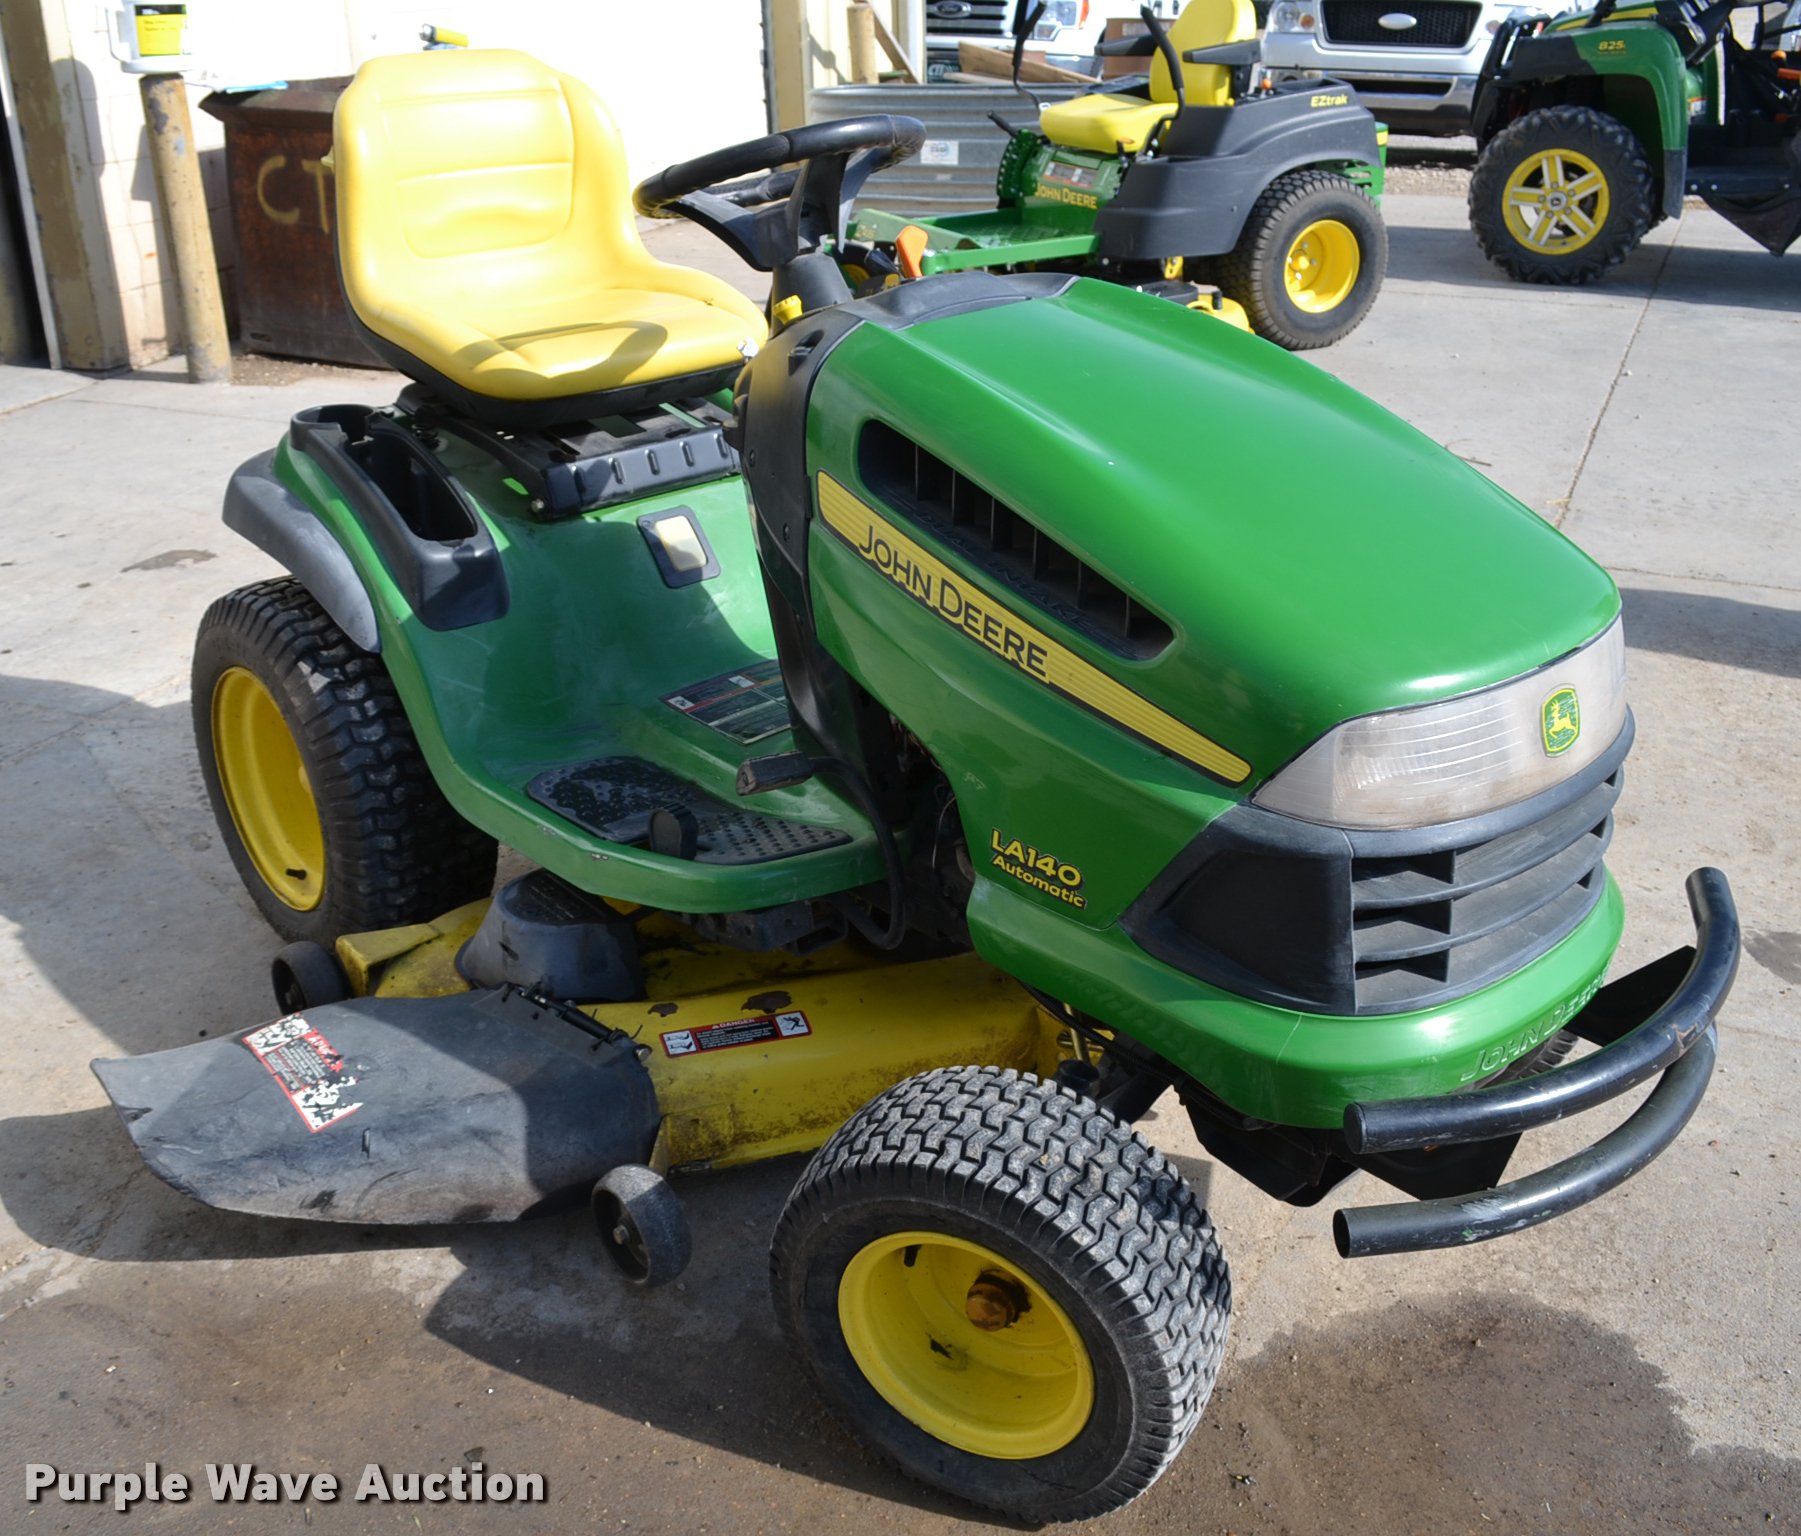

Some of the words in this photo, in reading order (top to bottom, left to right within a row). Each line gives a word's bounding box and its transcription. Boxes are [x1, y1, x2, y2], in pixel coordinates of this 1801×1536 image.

[1310, 93, 1349, 107] EZtrak
[1034, 183, 1061, 200] JOHN
[1062, 188, 1098, 209] DEERE
[859, 525, 931, 601] JOHN
[940, 577, 1048, 670] DEERE
[991, 828, 1083, 888] LA140
[992, 855, 1086, 909] Automatic
[719, 1018, 755, 1029] DANGER
[1460, 1021, 1544, 1082] JOHN
